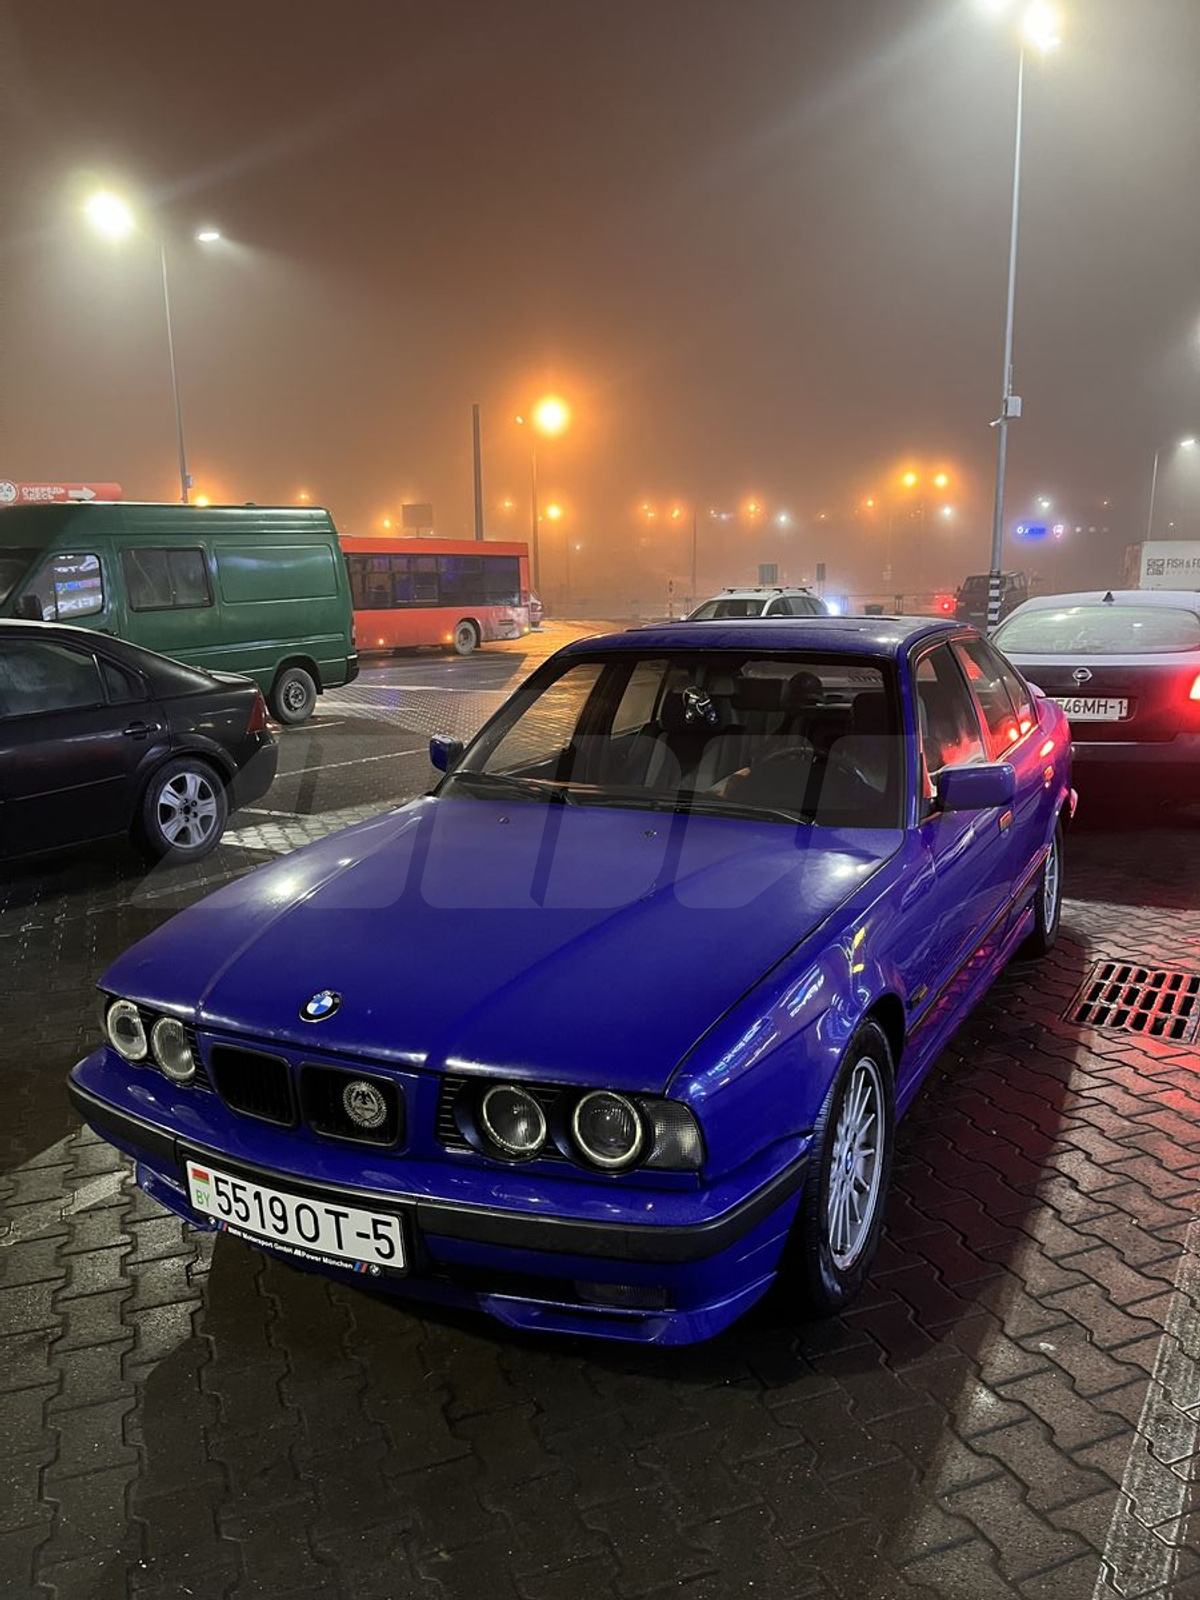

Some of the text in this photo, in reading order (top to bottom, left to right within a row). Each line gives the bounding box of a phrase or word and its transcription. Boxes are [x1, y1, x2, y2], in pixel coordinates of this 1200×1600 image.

[1166, 558, 1184, 568] FISH
[1050, 699, 1124, 715] 546MH-1
[196, 1189, 211, 1208] BY
[242, 1232, 273, 1249] Motorsport
[322, 1256, 354, 1269] München
